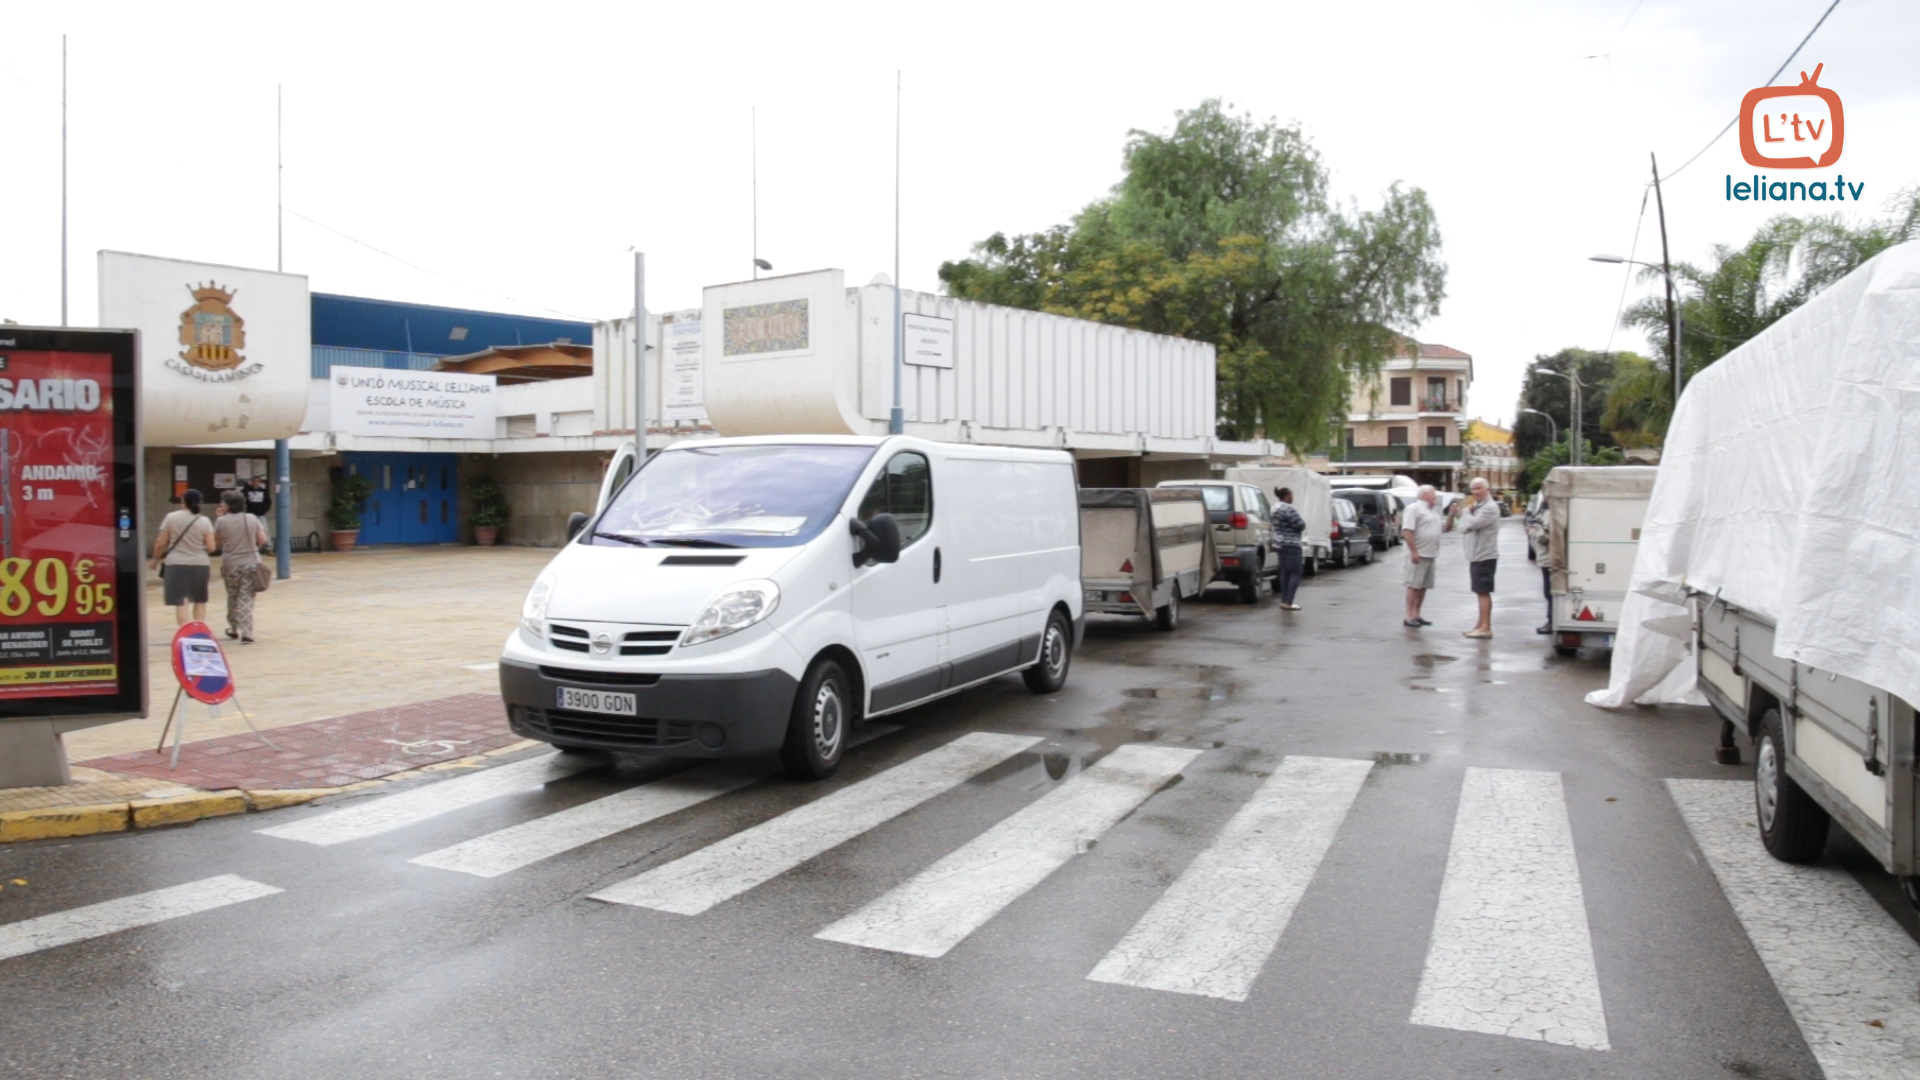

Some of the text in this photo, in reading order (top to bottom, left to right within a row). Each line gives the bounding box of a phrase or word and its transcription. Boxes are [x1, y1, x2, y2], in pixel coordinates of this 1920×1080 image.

[351, 374, 384, 389] UNIÓ
[388, 378, 442, 393] MUSICAL
[0, 378, 101, 412] SARIO
[366, 395, 406, 407] ESCOLA
[409, 397, 423, 408] DE
[22, 465, 97, 481] ANDAMIO
[22, 485, 54, 501] 3 m
[0, 557, 69, 617] 89
[75, 583, 114, 616] 95
[69, 629, 96, 638] QUART
[62, 638, 104, 647] DE POBLET
[24, 671, 37, 680] 30
[39, 670, 52, 679] DE
[54, 668, 113, 678] SEPTIEMBRE
[566, 691, 633, 712] 3900 GDN
